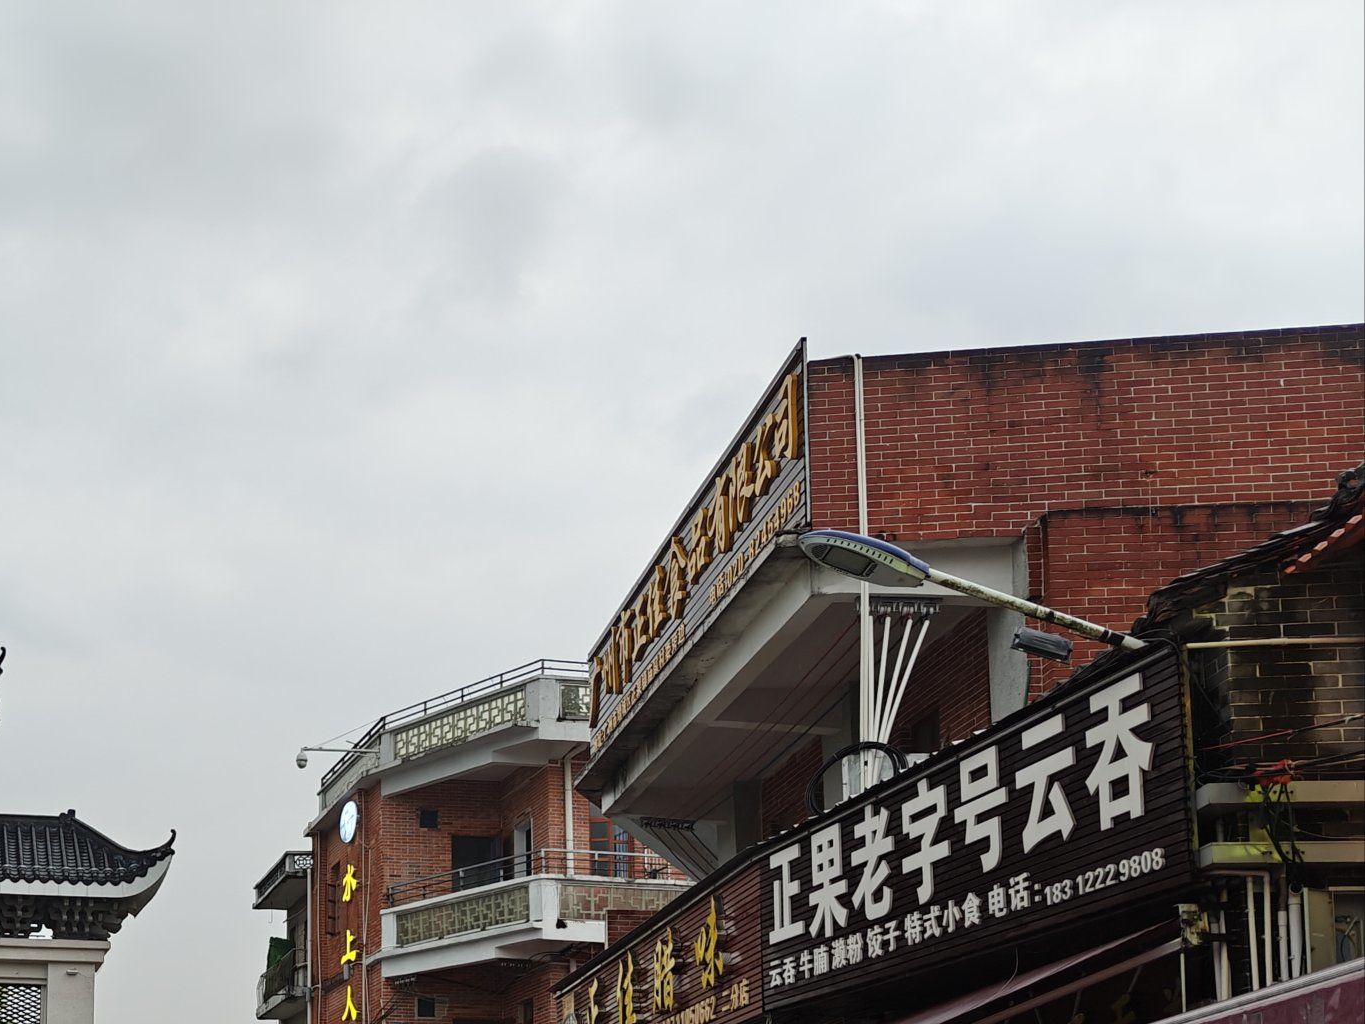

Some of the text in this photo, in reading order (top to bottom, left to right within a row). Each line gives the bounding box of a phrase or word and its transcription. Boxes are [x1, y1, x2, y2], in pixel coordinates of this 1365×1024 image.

[768, 672, 1154, 945] 正果老字号云吞
[769, 957, 796, 988] 云吞
[799, 944, 830, 979] 牛腩
[866, 919, 902, 959] 饺子
[904, 892, 983, 945] 特式小食
[1044, 879, 1073, 905] 183
[1076, 864, 1118, 895] 1222
[1119, 848, 1166, 882] 9808
[721, 979, 750, 1013] 二分店
